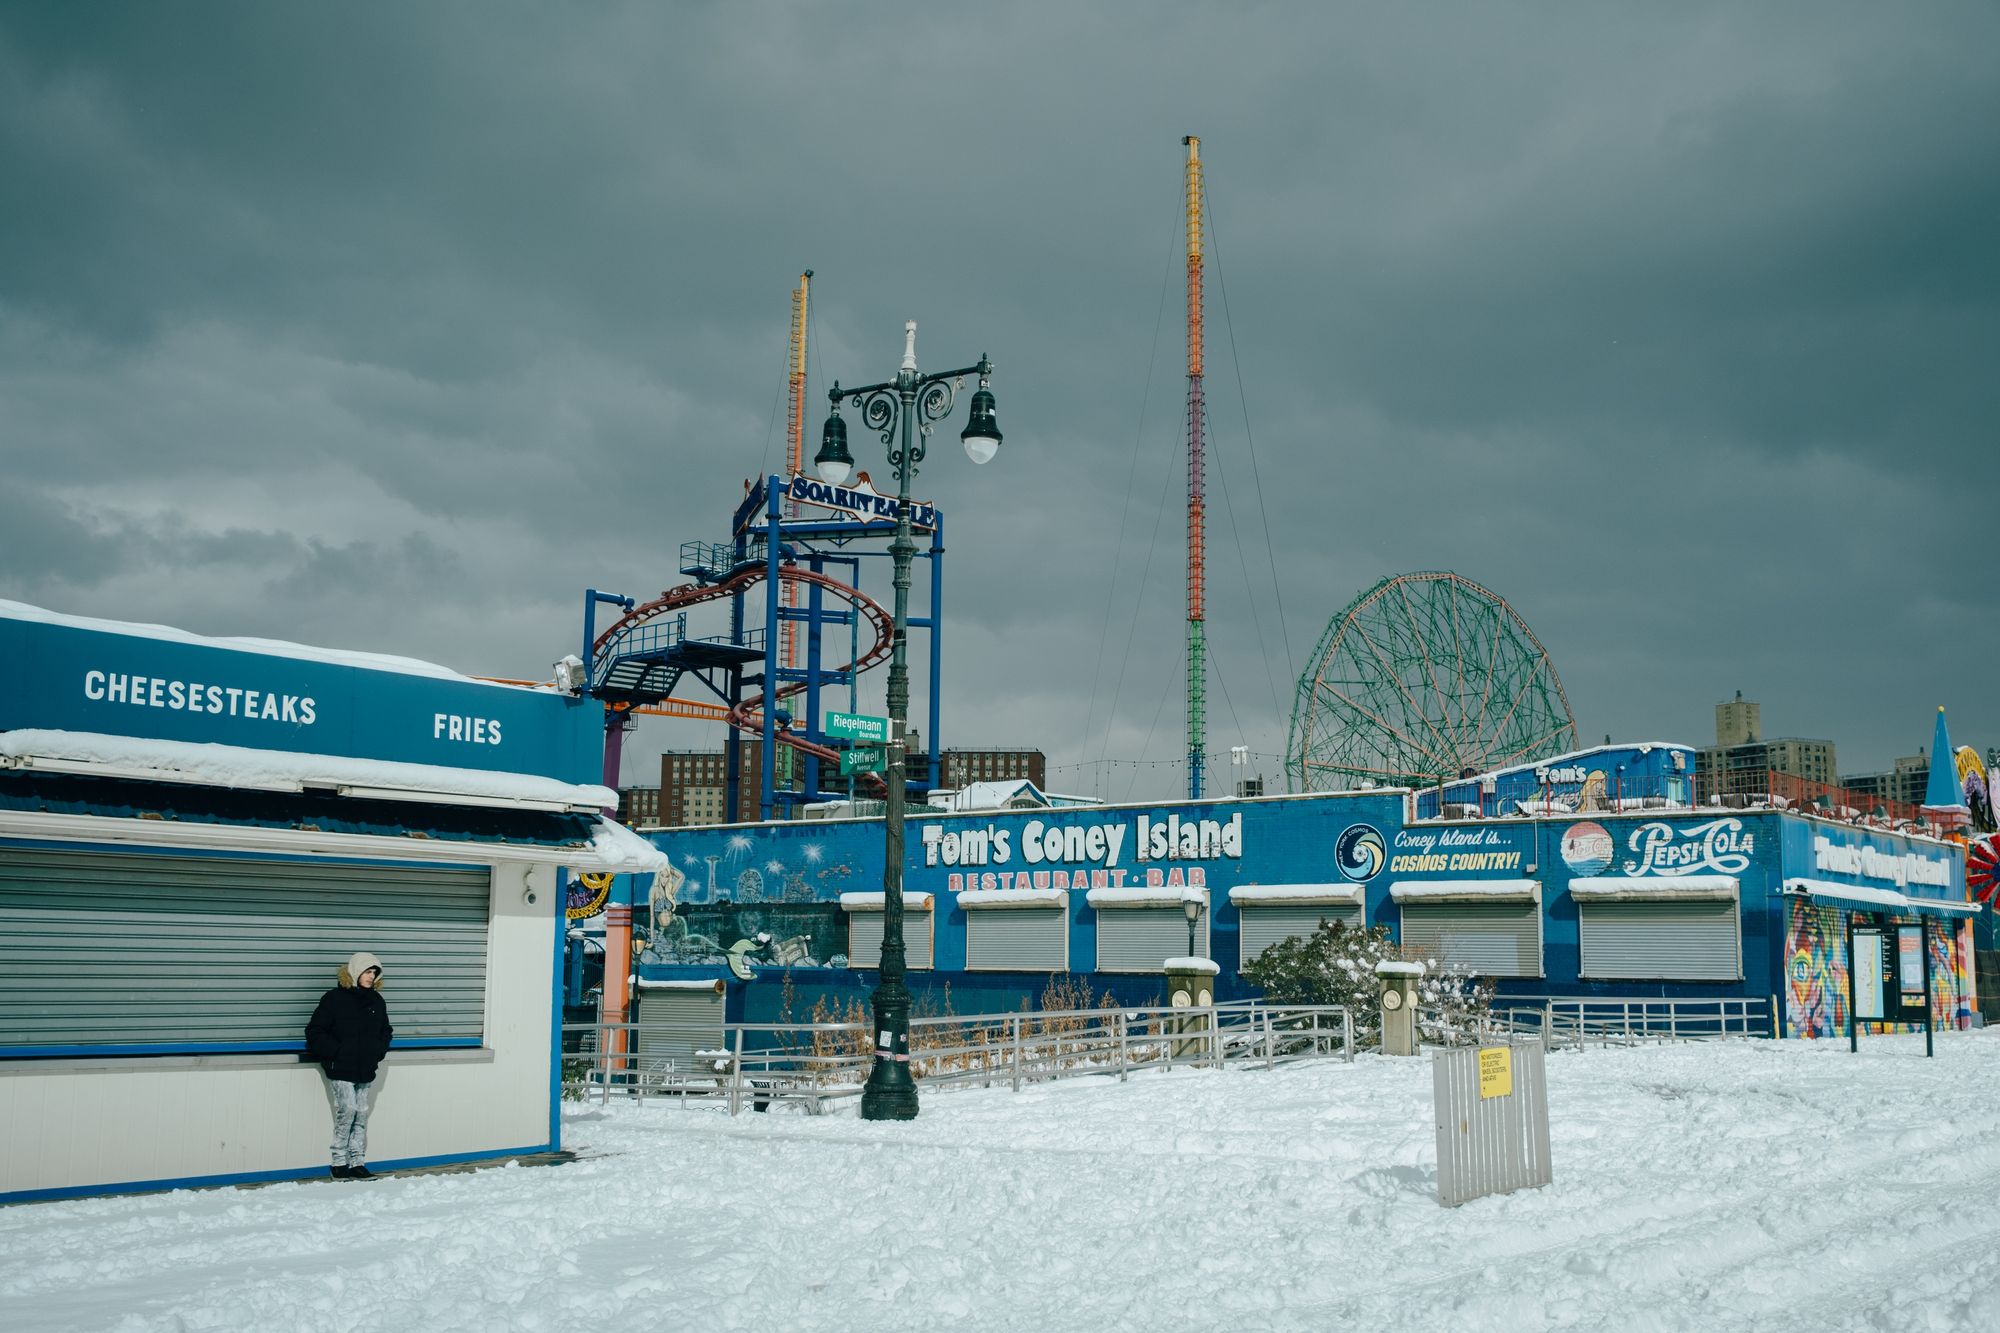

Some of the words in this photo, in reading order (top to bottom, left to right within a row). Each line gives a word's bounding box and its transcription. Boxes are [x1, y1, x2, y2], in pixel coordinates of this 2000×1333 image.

[873, 497, 934, 527] EALE
[84, 670, 316, 724] CHEESESTEAKS
[434, 713, 502, 745] FRIES
[833, 714, 882, 732] Riegelmann
[859, 731, 881, 739] Boardwalk
[848, 751, 880, 765] Stillwell
[1535, 765, 1587, 784] Tom's
[922, 824, 1011, 866] Tom's
[1022, 820, 1127, 867] Coney
[1137, 812, 1242, 861] Island
[1394, 830, 1436, 855] Coney
[1438, 828, 1486, 847] Island
[1486, 830, 1511, 845] is...
[1390, 854, 1448, 872] COSMOS
[1449, 851, 1521, 870] COUNTRY!
[948, 869, 1127, 891] RESTAURANT
[1146, 867, 1206, 889] BAR
